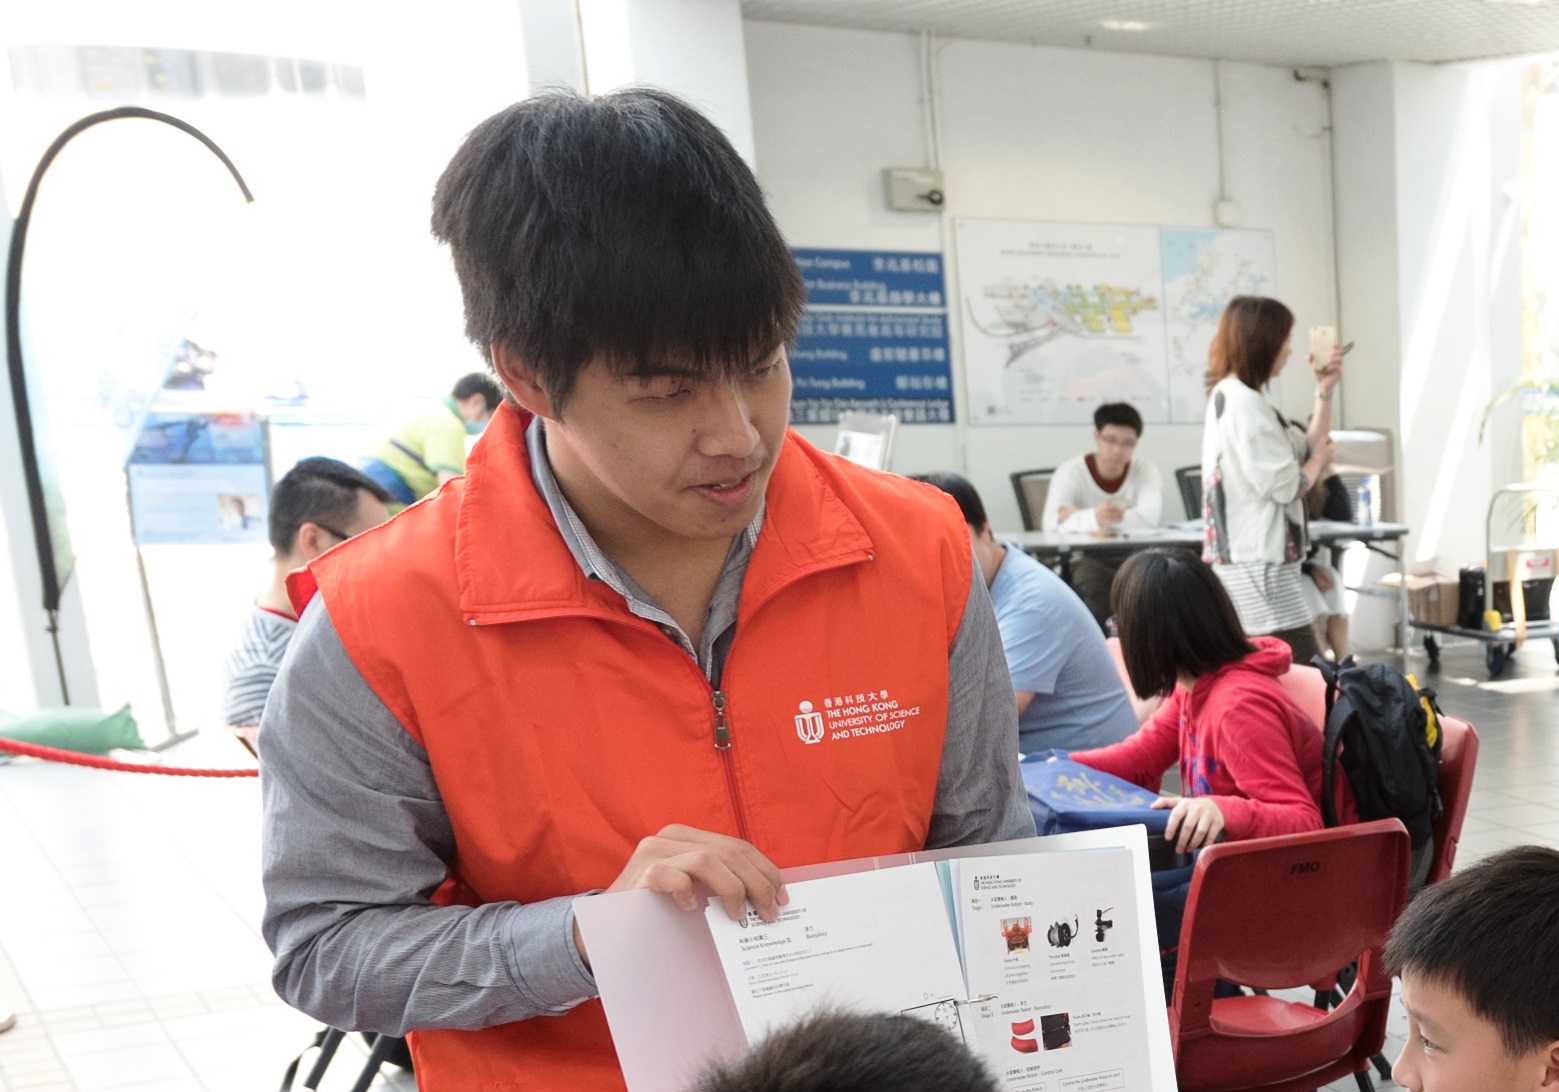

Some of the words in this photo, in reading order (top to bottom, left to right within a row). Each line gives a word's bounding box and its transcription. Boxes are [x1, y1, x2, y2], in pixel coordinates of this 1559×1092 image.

[824, 690, 889, 708] 香港科技大學
[826, 709, 842, 718] THE
[843, 704, 870, 716] HONG
[872, 700, 898, 712] KONG
[828, 716, 873, 730] UNIVERSITY
[875, 712, 888, 722] OF
[890, 706, 920, 720] SCIENCE
[832, 730, 850, 740] AND
[850, 720, 906, 738] TECHNOLOGY
[1290, 860, 1320, 875] FMO
